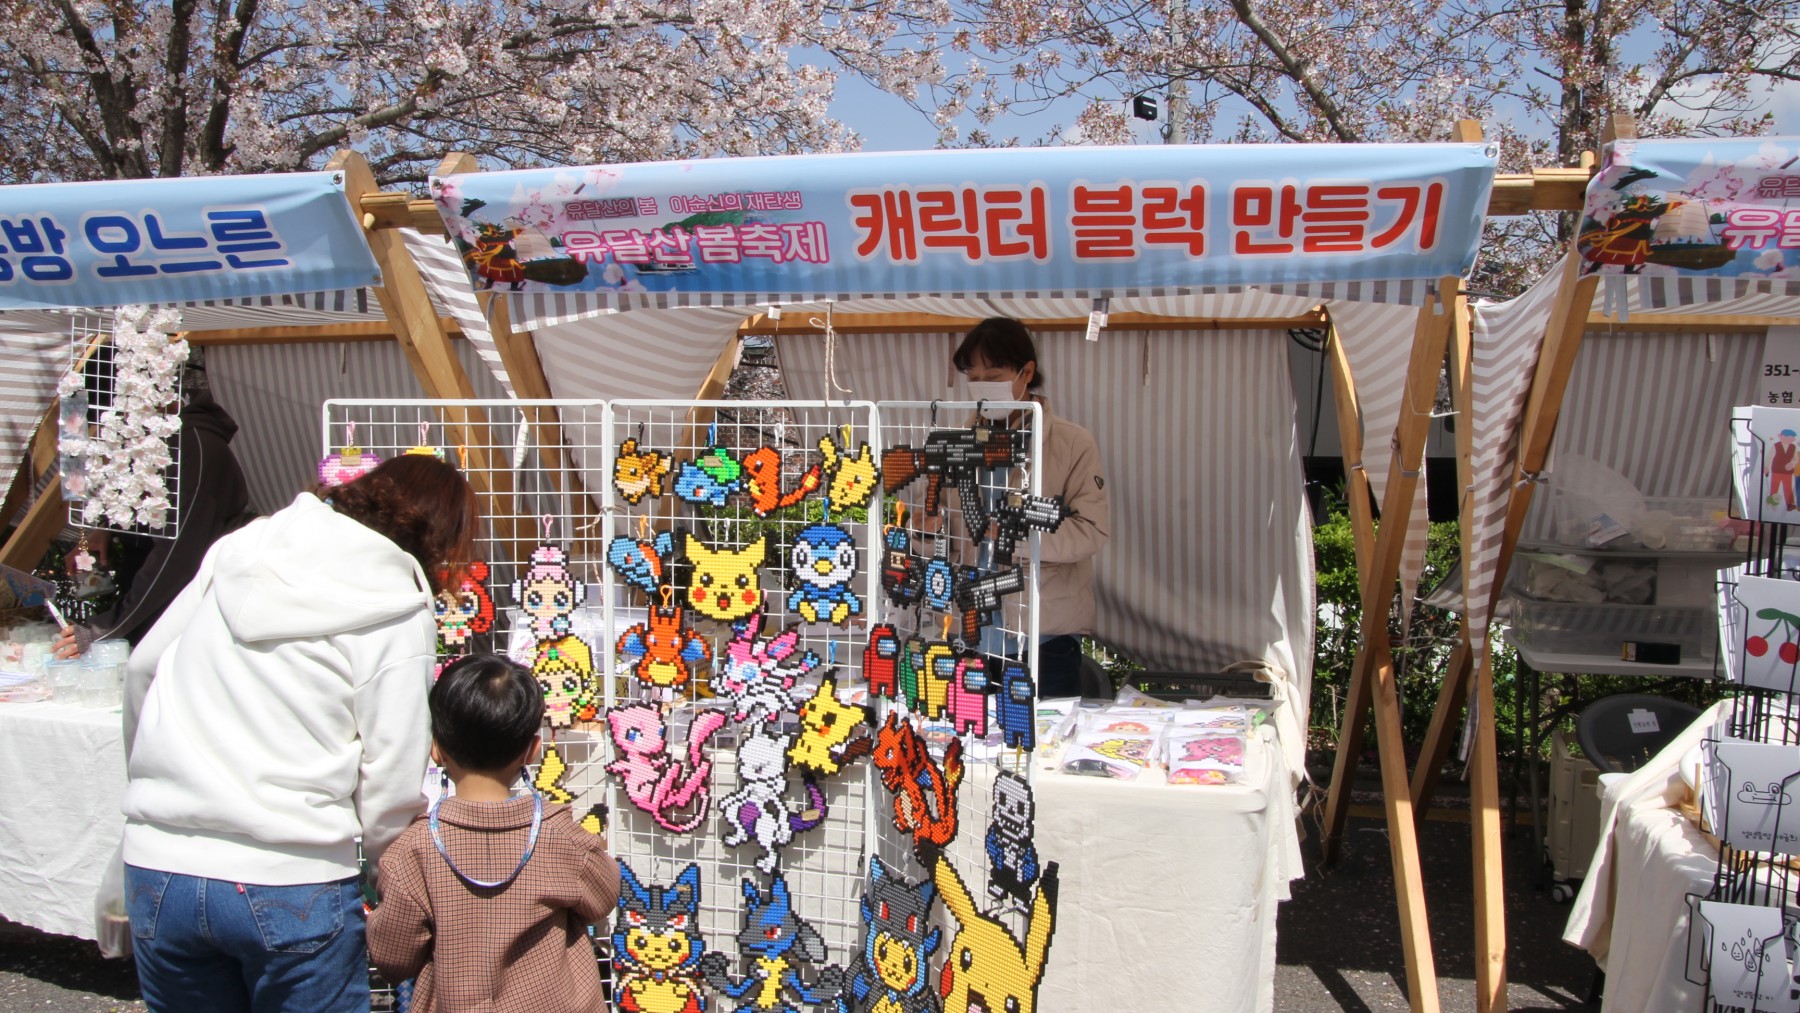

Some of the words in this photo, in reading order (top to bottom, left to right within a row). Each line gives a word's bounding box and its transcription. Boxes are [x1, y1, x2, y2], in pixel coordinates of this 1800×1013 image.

[565, 198, 636, 220] 유달산의
[637, 196, 658, 215] 봄
[670, 193, 742, 213] 이순신의
[745, 191, 803, 211] 재탄생
[850, 185, 1048, 261] 캐릭터
[1071, 184, 1205, 258] 블럭
[1232, 182, 1444, 254] 만들기
[84, 210, 290, 278] 오느른
[562, 228, 693, 264] 유달산
[697, 222, 830, 264] 봄축제
[1763, 364, 1800, 376] 351-
[1767, 391, 1793, 404] 농협
